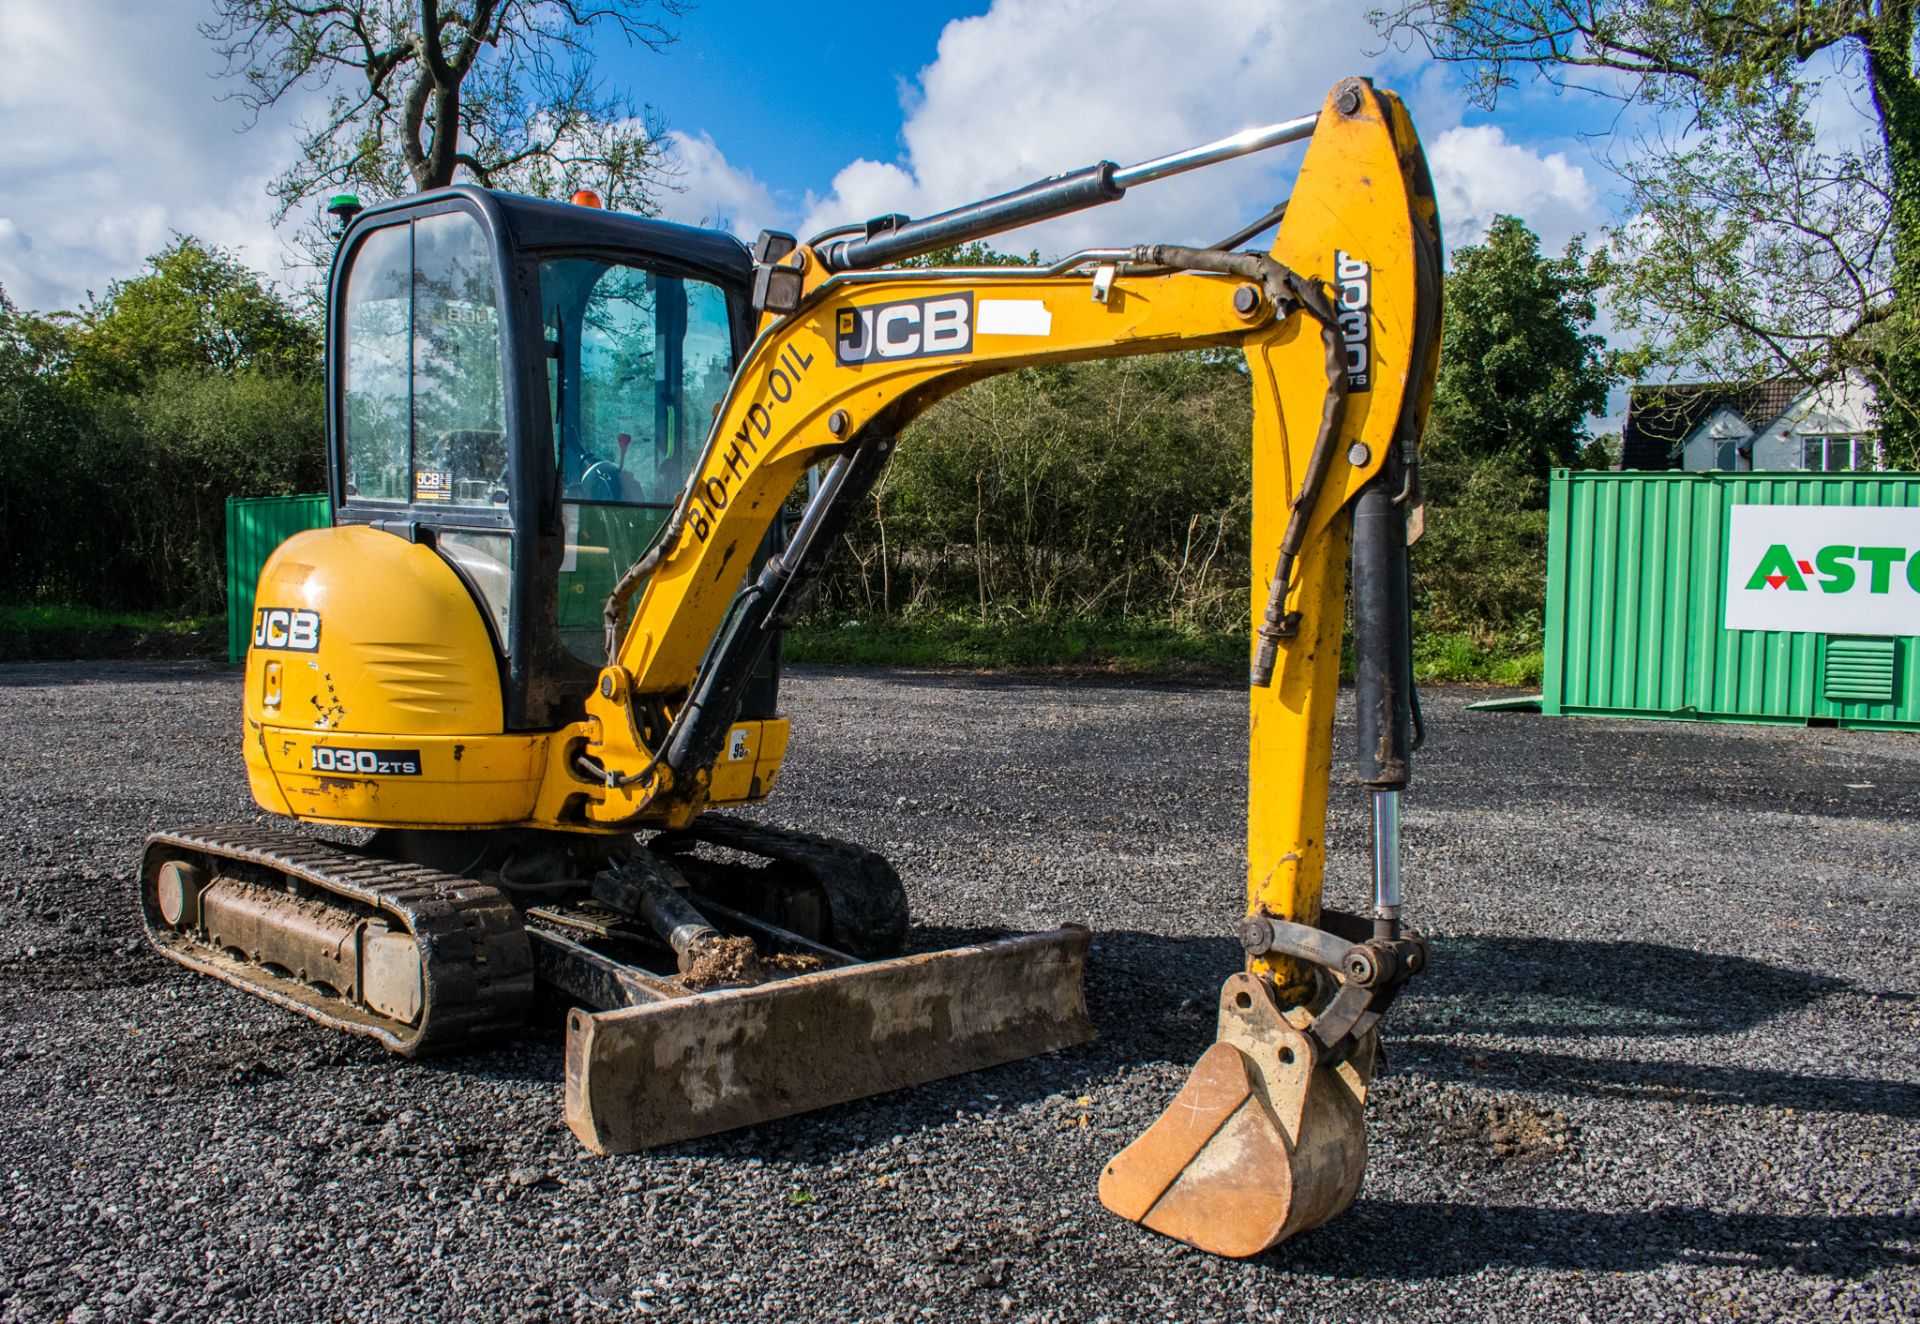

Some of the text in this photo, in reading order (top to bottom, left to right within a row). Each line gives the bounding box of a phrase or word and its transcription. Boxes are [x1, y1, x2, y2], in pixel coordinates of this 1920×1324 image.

[839, 299, 969, 361] JCB
[688, 342, 814, 544] BIO-HYD-OIL
[254, 610, 319, 649] JCB
